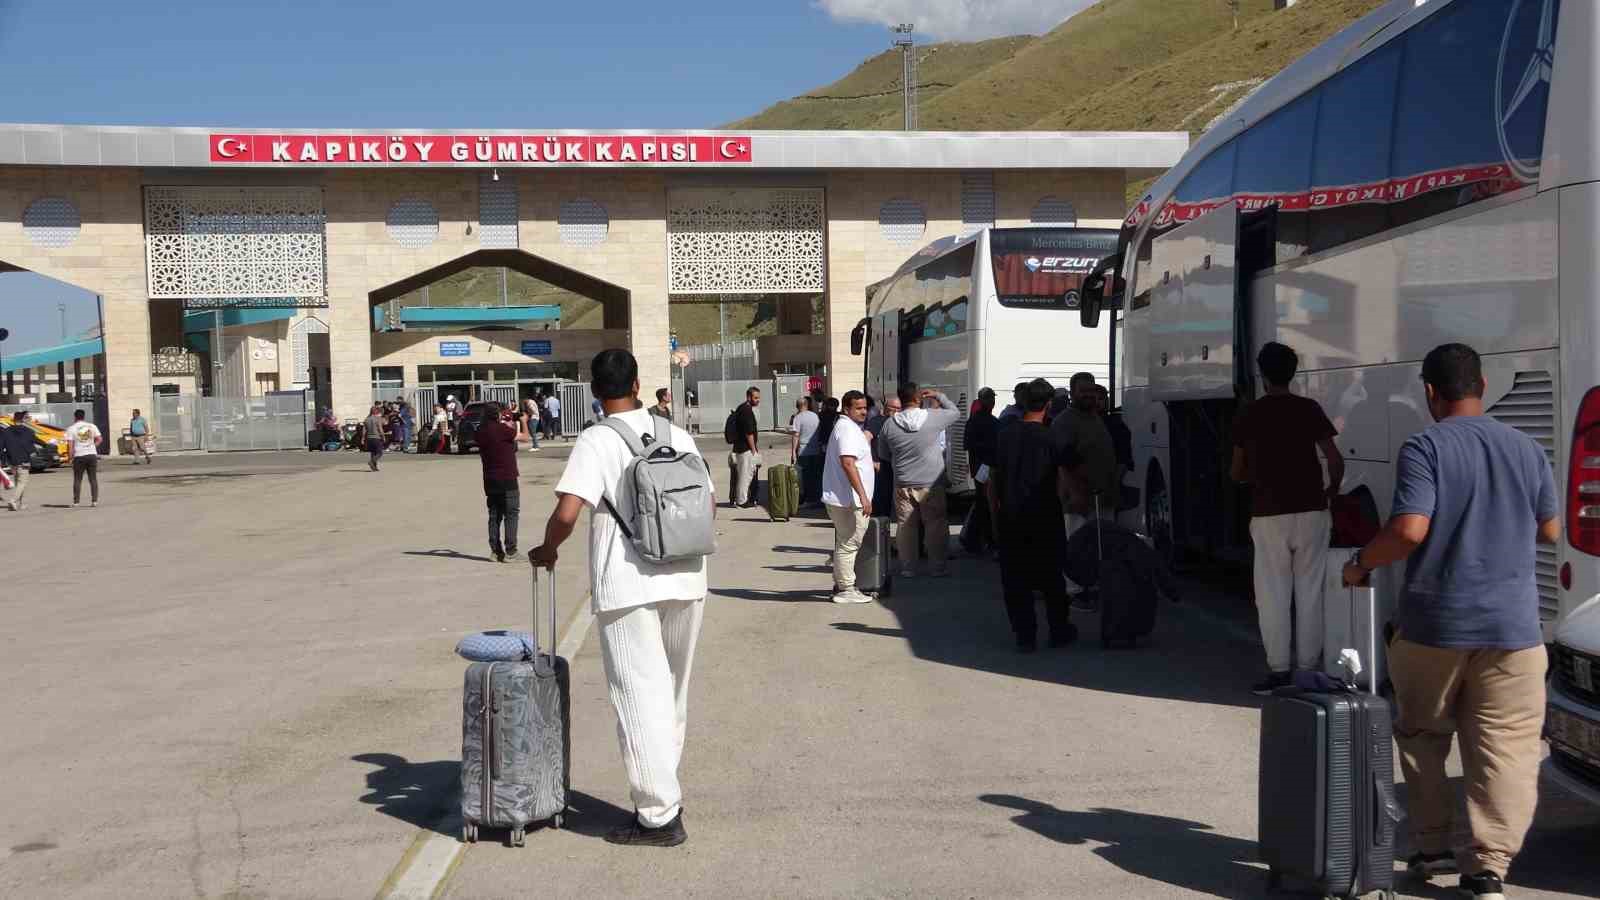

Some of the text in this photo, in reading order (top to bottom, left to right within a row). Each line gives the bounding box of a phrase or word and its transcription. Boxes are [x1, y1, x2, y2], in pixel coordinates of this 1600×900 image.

[272, 136, 697, 162] KAPIKÖY GÜMRÜK KAPISI
